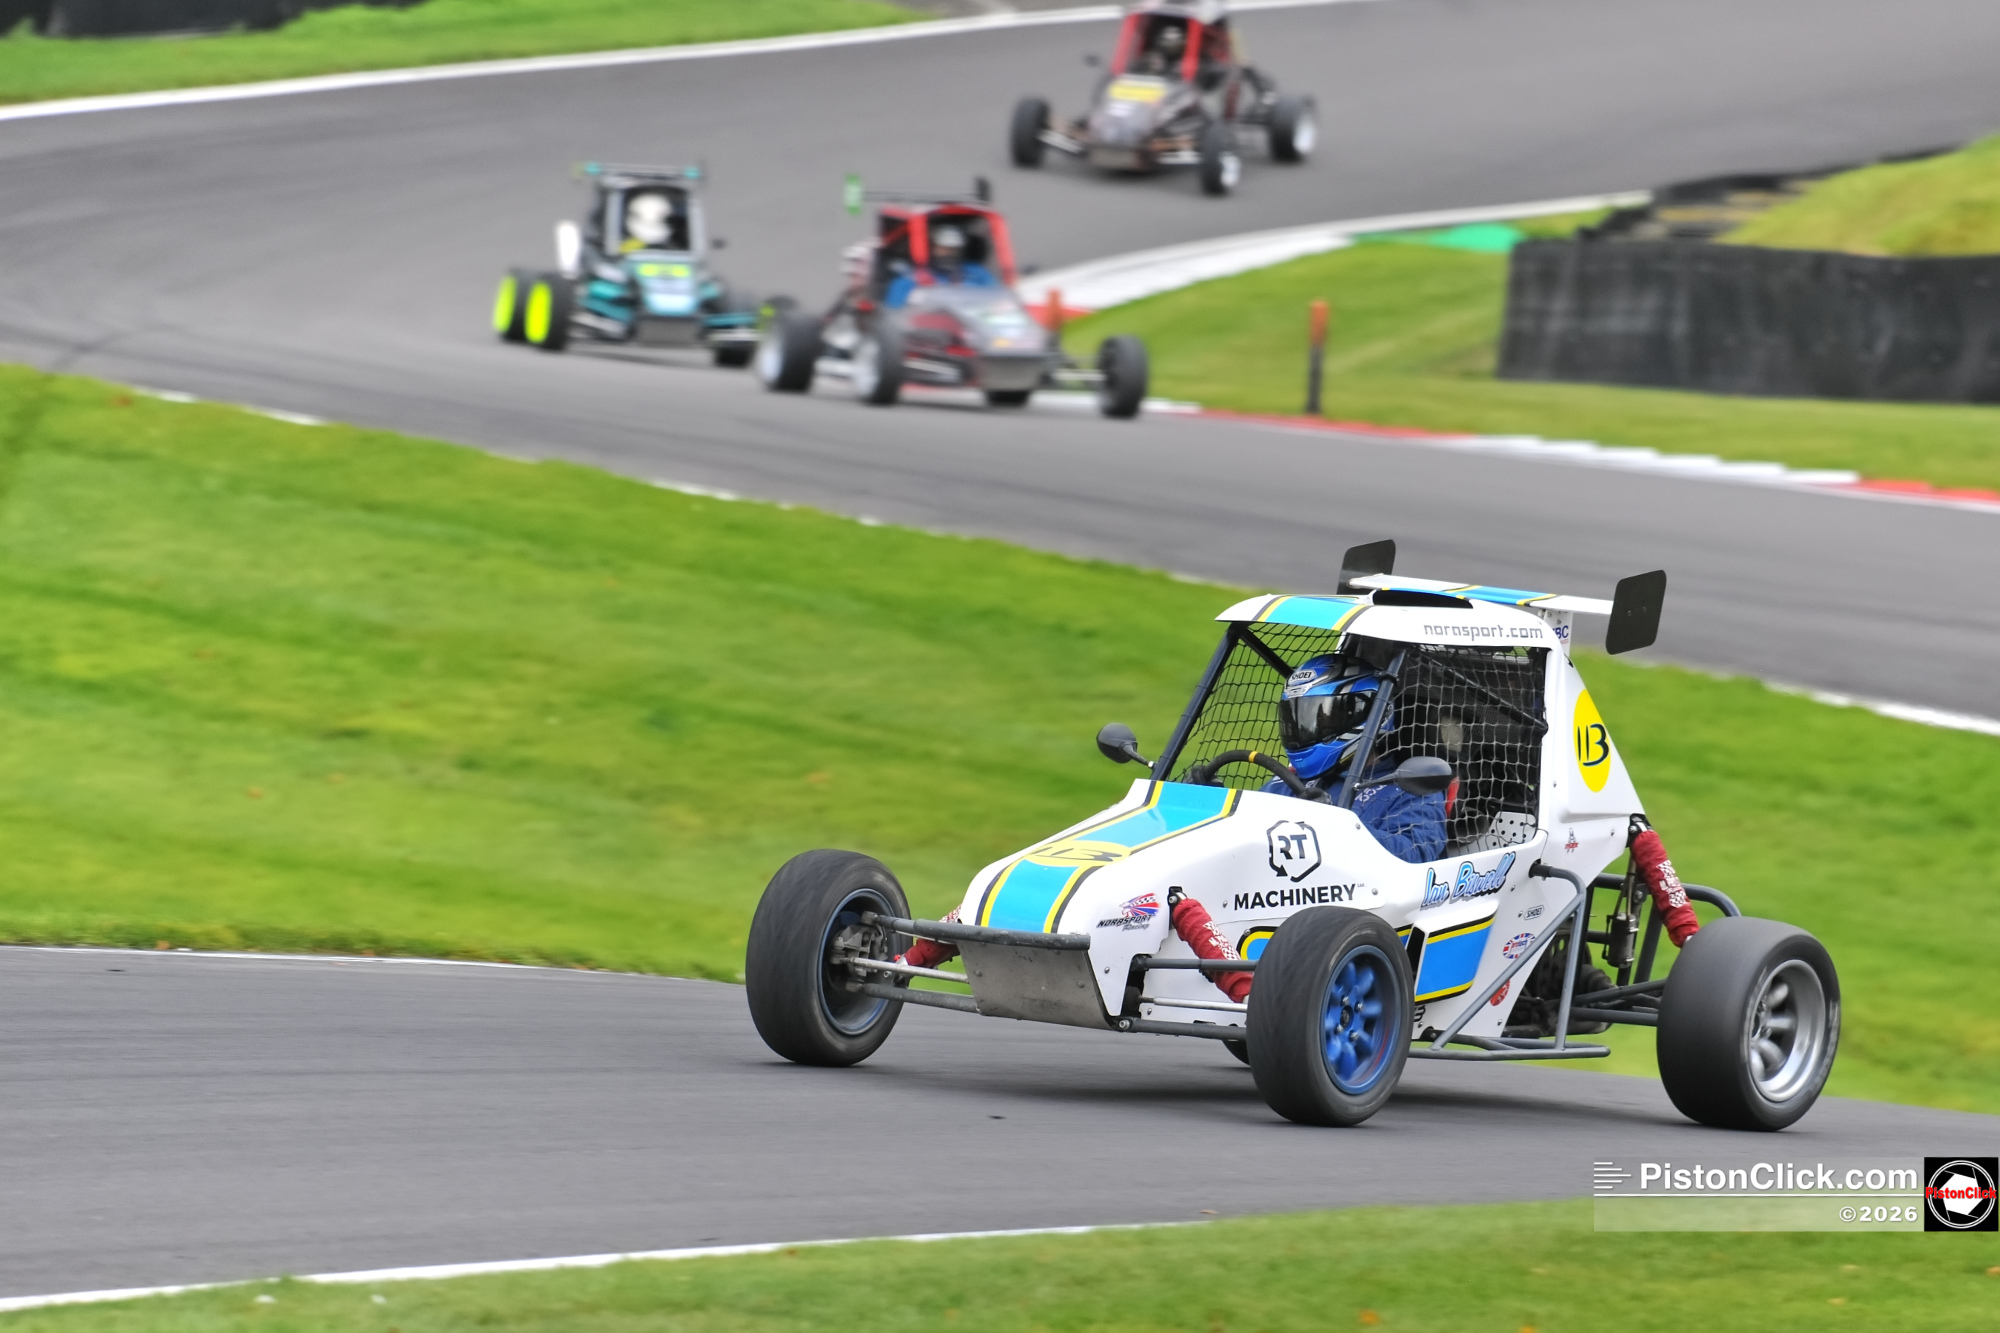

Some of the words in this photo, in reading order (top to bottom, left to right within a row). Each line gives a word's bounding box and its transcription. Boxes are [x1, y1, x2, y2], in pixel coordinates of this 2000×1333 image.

[1552, 624, 1569, 639] BC
[1277, 833, 1308, 861] RT
[1234, 883, 1356, 911] MACHINERY
